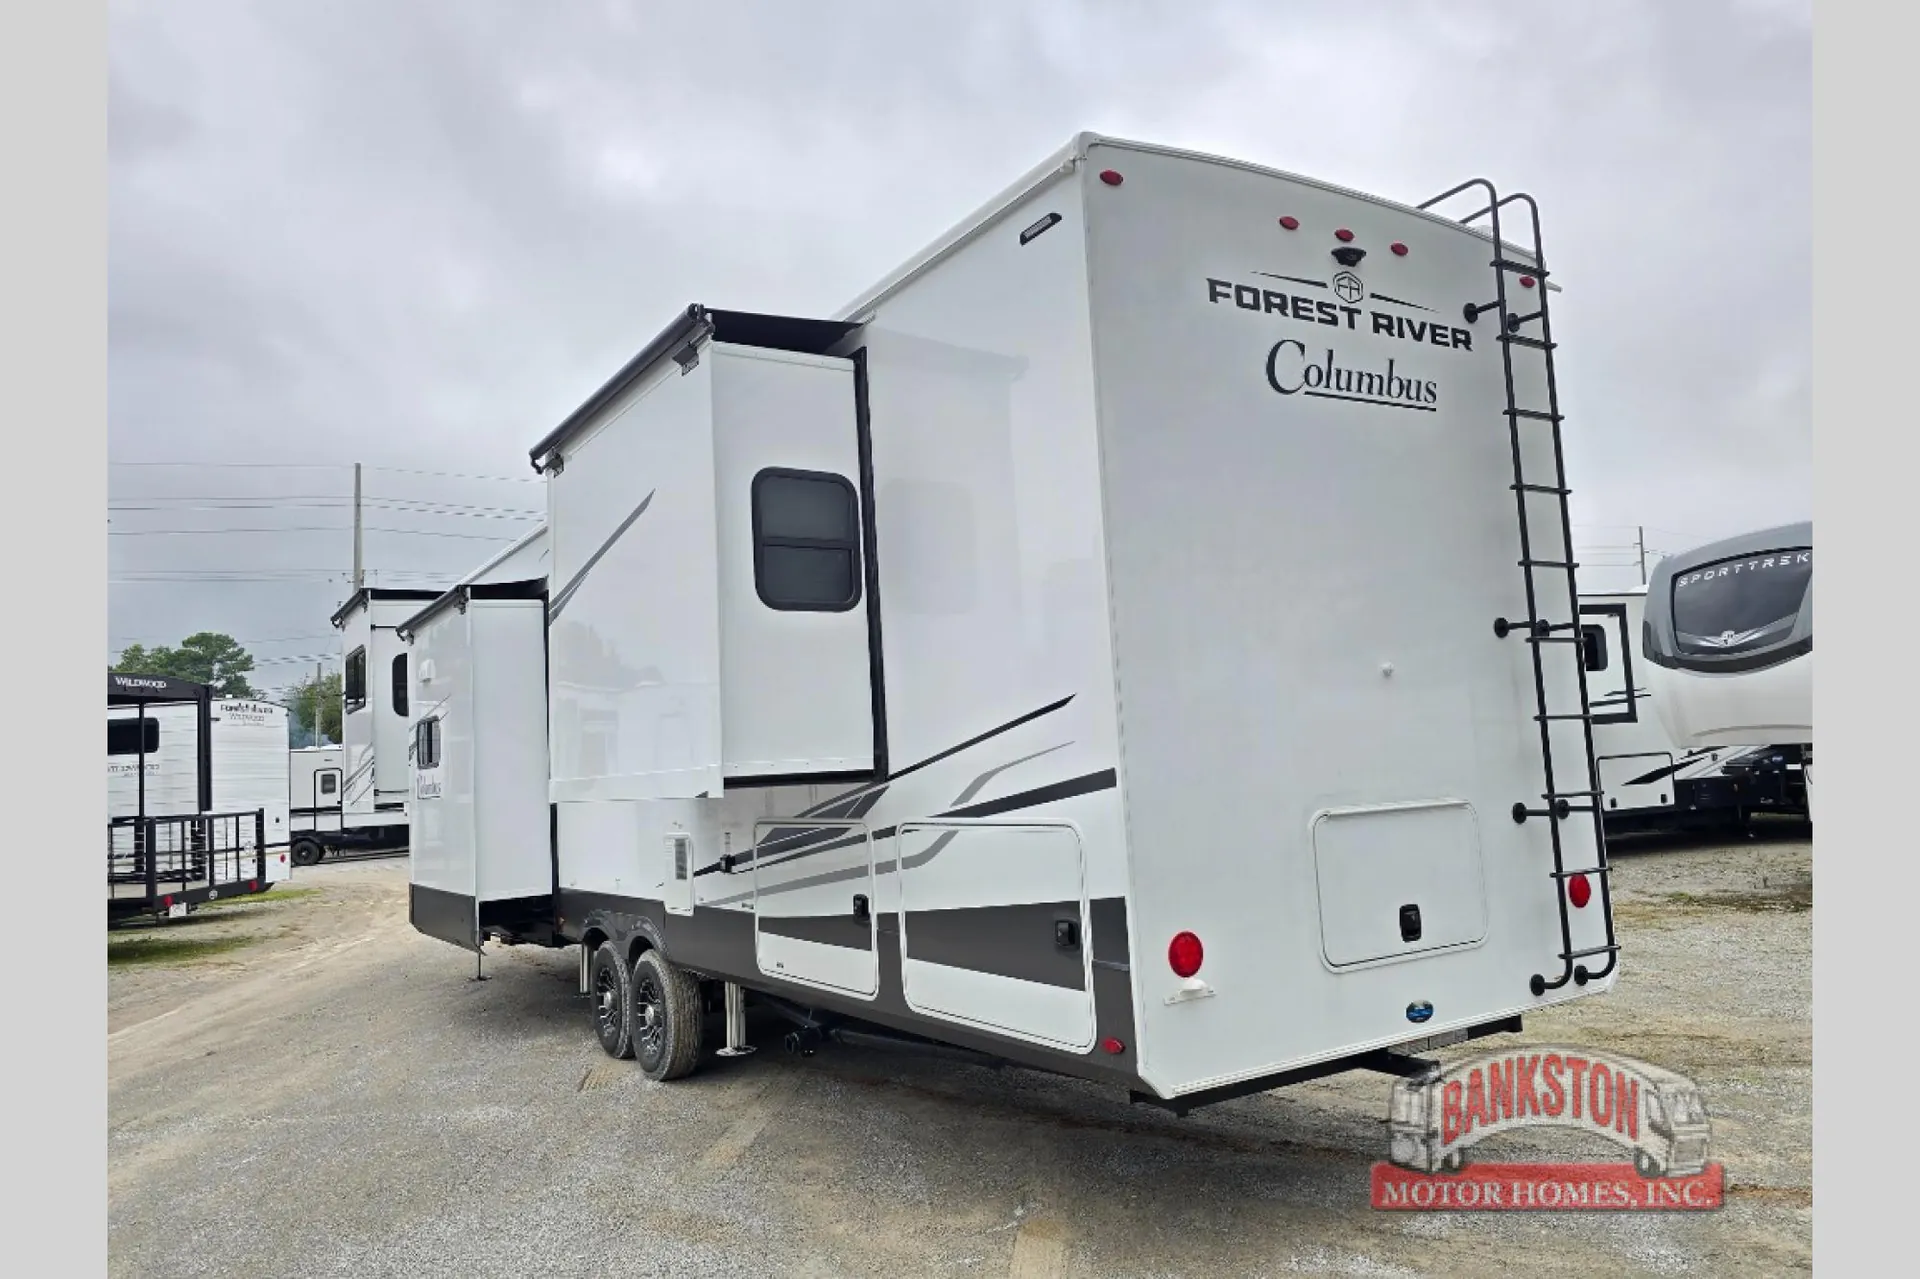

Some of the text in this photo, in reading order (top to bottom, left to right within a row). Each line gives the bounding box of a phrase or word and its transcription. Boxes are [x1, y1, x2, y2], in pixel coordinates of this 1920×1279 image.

[1206, 278, 1362, 330] FOREST
[1370, 311, 1473, 351] RIVER
[1266, 339, 1437, 405] Columbus
